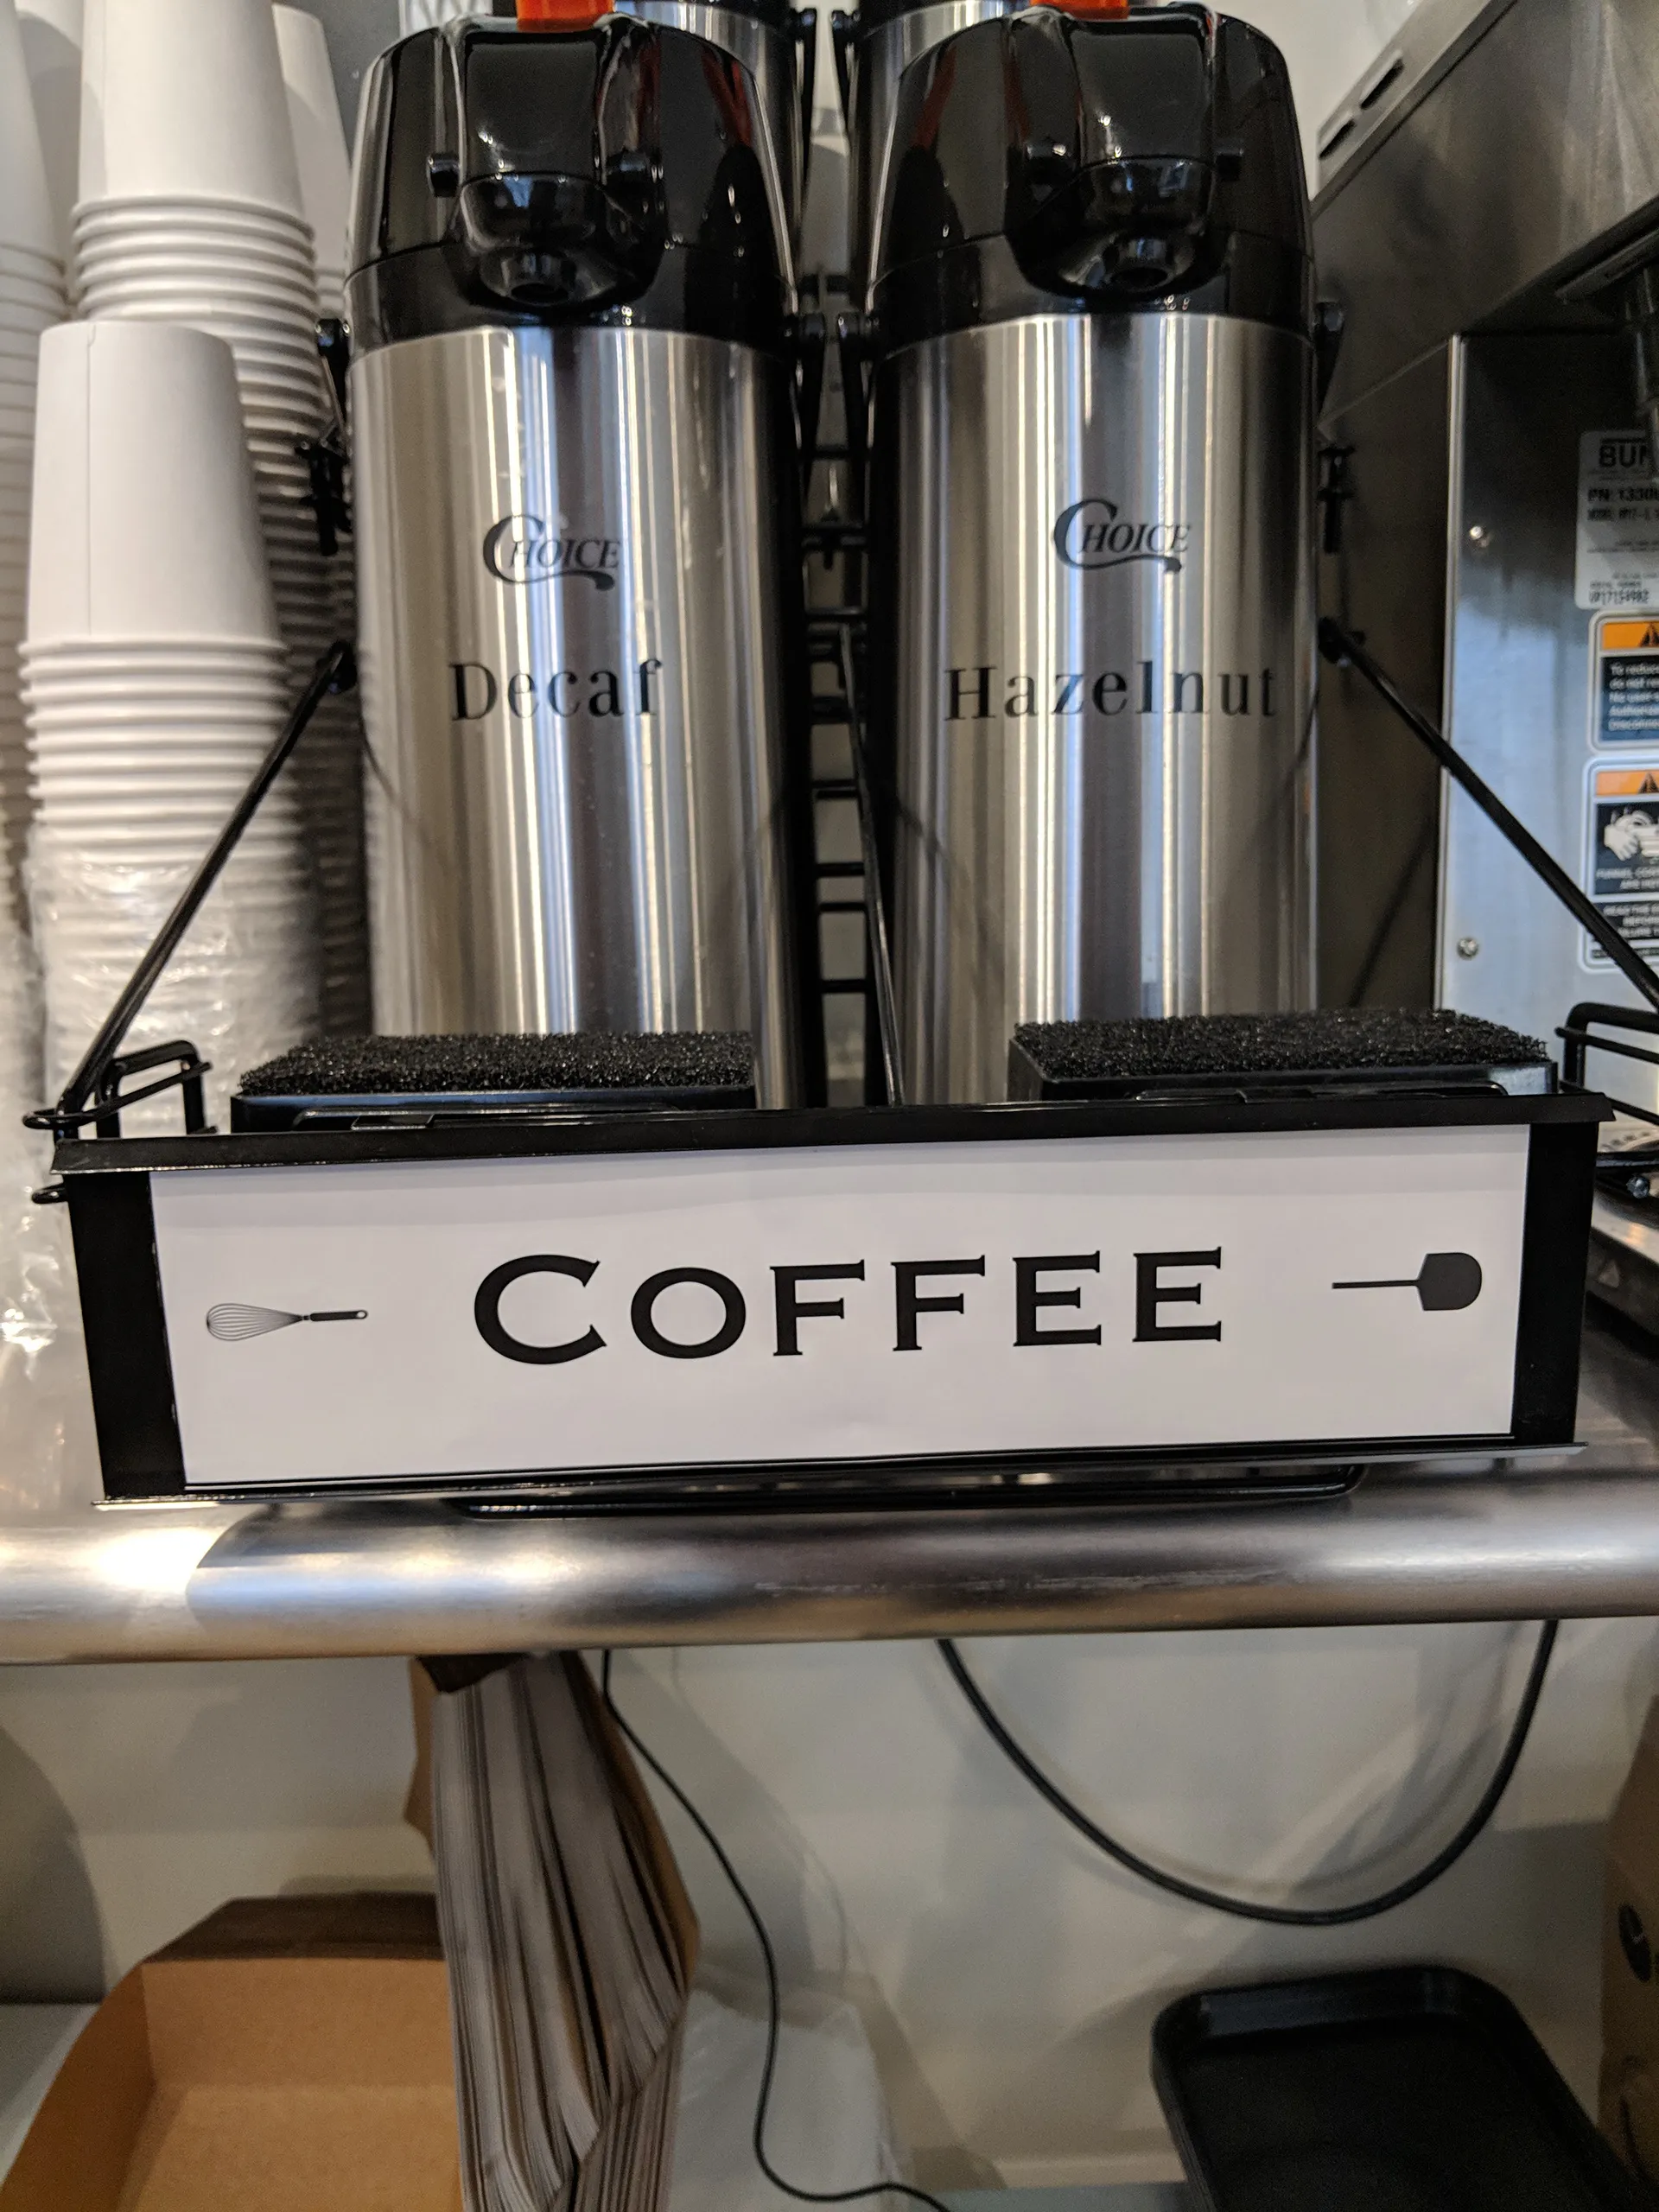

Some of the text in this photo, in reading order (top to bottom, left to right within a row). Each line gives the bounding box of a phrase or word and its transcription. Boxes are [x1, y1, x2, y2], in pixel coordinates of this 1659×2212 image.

[448, 658, 663, 721] Decaf
[944, 660, 1278, 721] Hazelnut
[474, 1246, 1223, 1366] COFFEE
